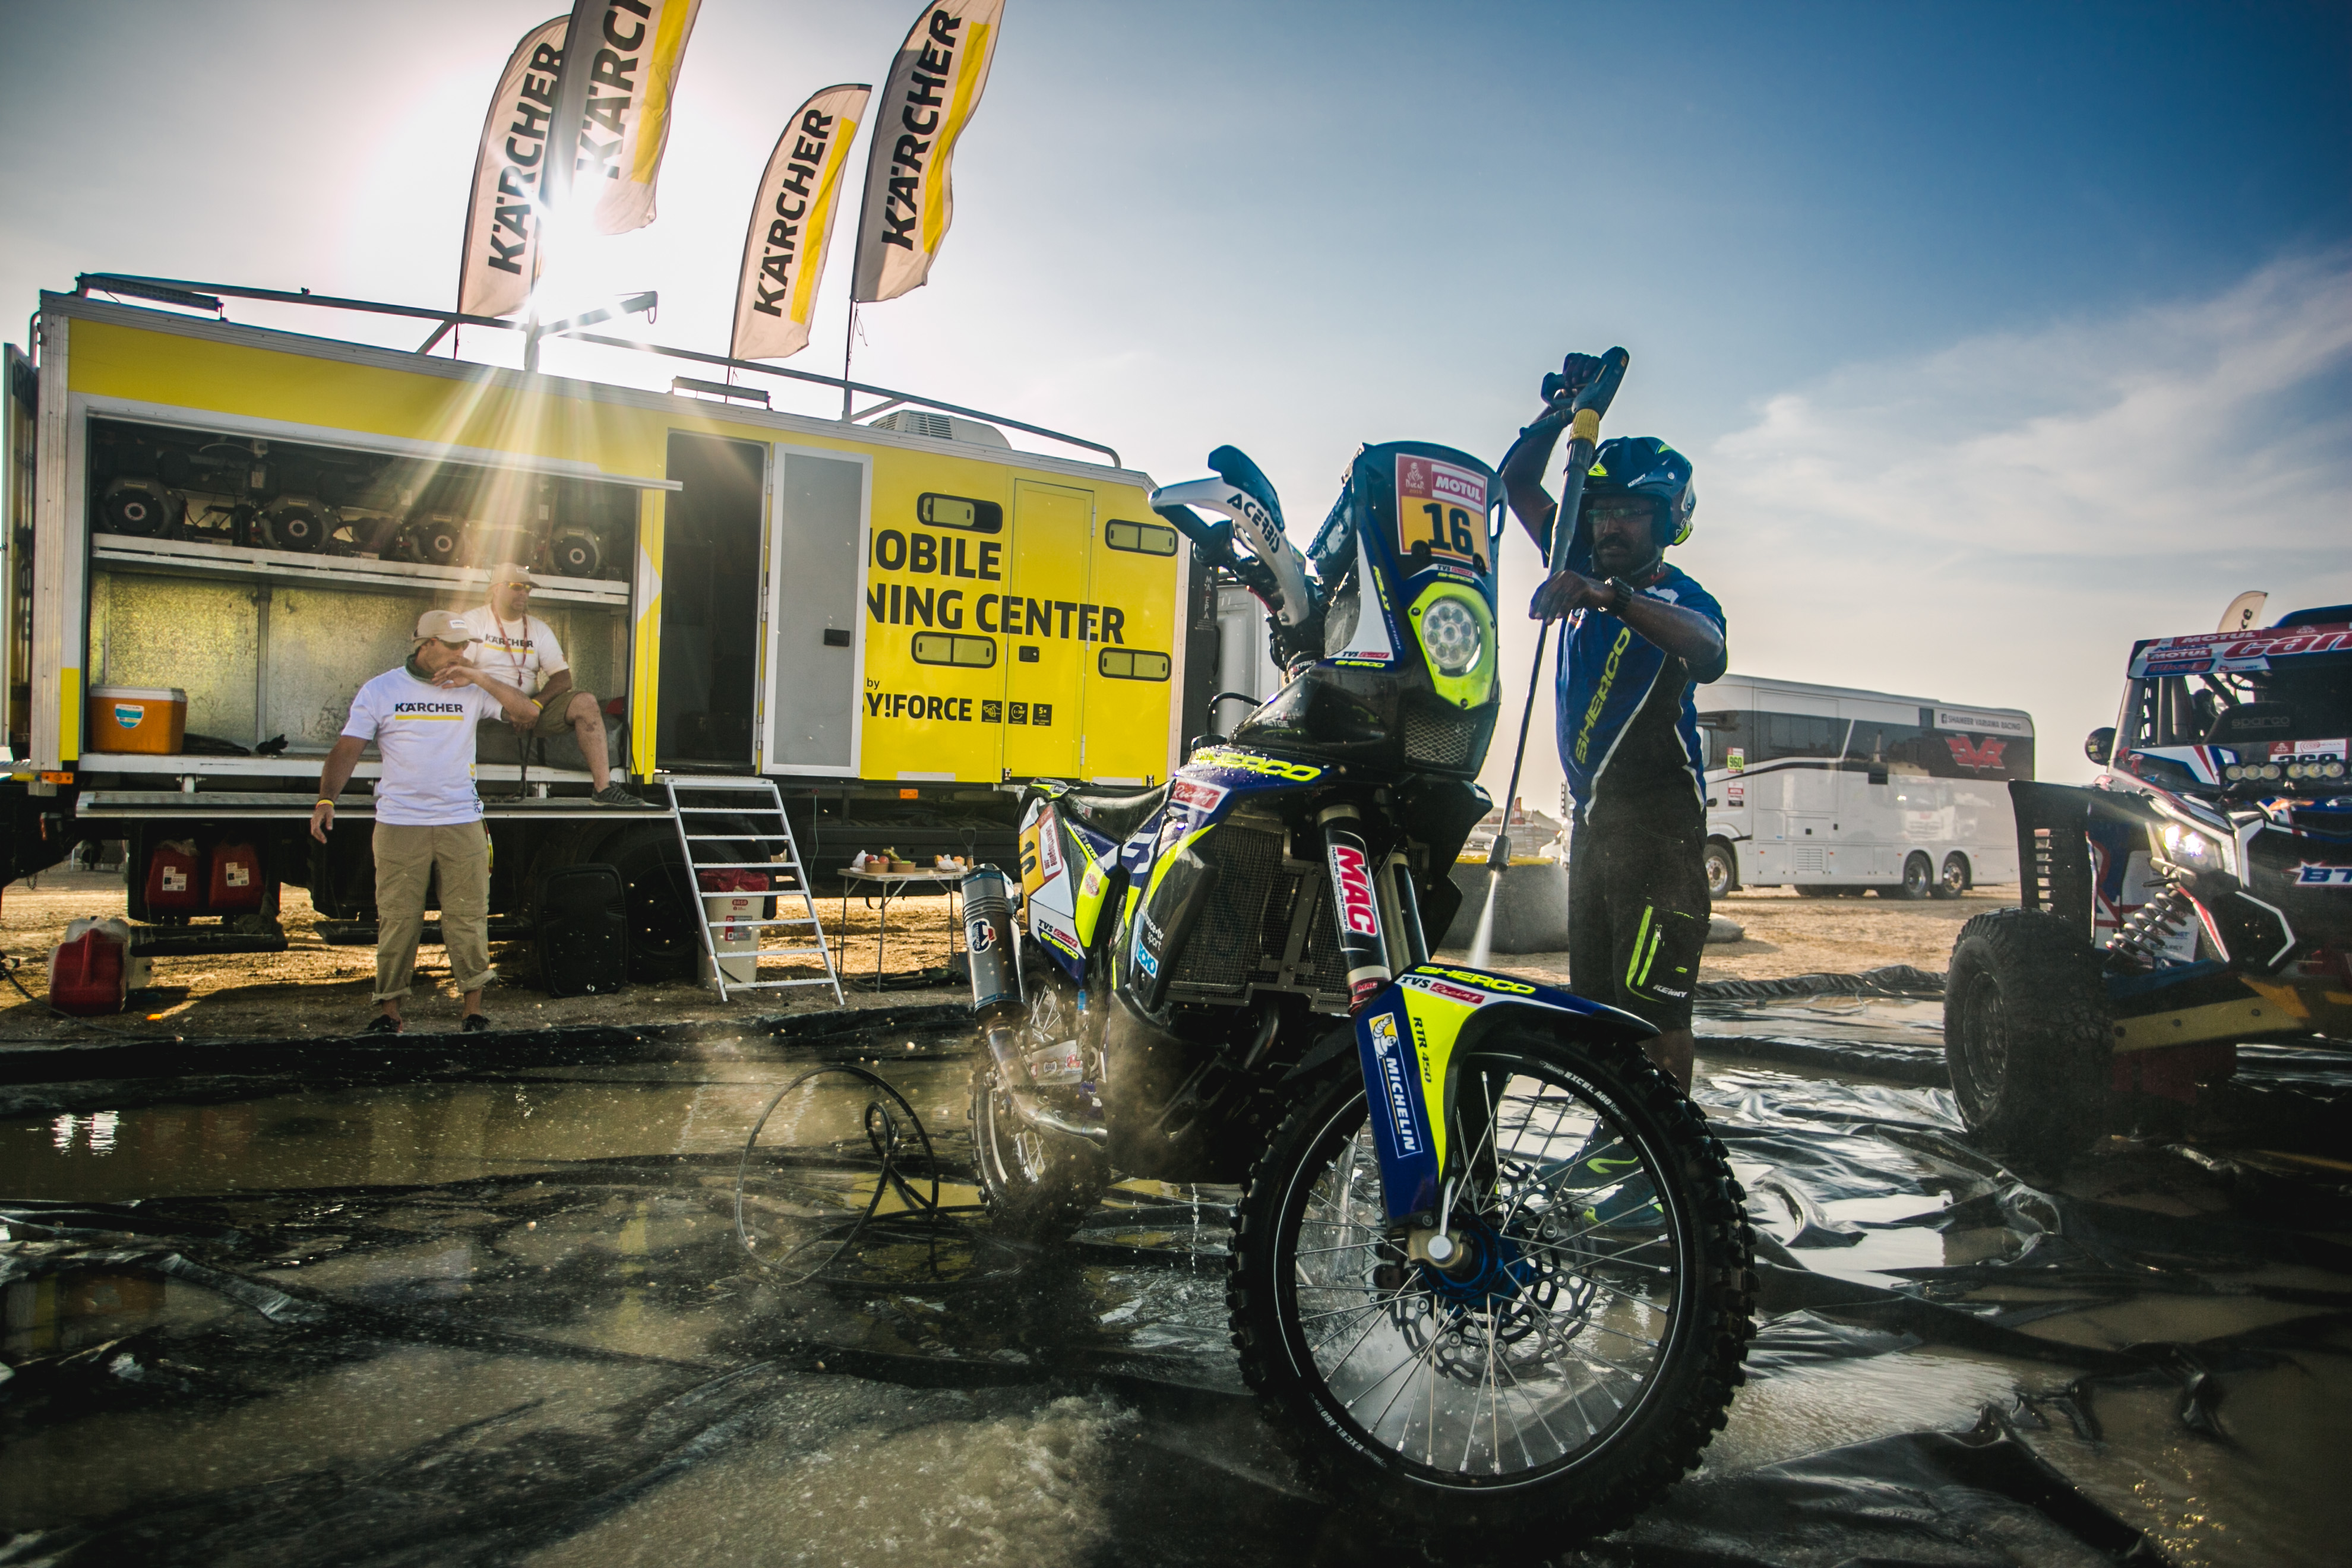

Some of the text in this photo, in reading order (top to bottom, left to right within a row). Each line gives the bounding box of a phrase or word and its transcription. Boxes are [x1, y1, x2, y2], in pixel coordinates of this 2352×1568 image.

[881, 10, 962, 251] KÄRCHER
[488, 42, 565, 275] KÄRCHER
[754, 109, 833, 318] KÄRCHER
[1436, 476, 1481, 501] MOTUL
[1422, 502, 1474, 556] 16
[976, 593, 1125, 644] CENTER
[2239, 609, 2253, 631] ce
[2182, 631, 2255, 644] MOTUL
[1335, 659, 1386, 668] SHERCO
[2149, 649, 2208, 660] MOTUL
[867, 678, 880, 690] by
[1576, 627, 1631, 764] SHERCO
[395, 703, 463, 713] KÄRCHER
[862, 693, 972, 722] Y!FORCE
[1948, 715, 1974, 725] SHAMEER
[2001, 720, 2021, 730] RACING
[2231, 716, 2290, 728] sparco
[1729, 756, 1742, 767] 960
[1336, 846, 1377, 936] MAC
[1337, 877, 1349, 931] SUSPENSION
[1039, 919, 1054, 932] TVS
[1041, 931, 1079, 960] SHERCO
[1147, 931, 1162, 951] sport
[1357, 981, 1377, 993] MAC
[1402, 976, 1484, 1003] TVS Racing
[1414, 965, 1536, 994] SHERCO
[1653, 984, 1688, 998] KENNY
[1413, 1016, 1432, 1084] RTR 450
[1386, 1057, 1416, 1151] MICHELIN
[1564, 1071, 1594, 1093] EXCEL
[1594, 1090, 1612, 1106] A60
[1609, 1102, 1627, 1121] Rim
[1320, 1411, 1337, 1427] A60
[1337, 1425, 1364, 1452] EXCEL
